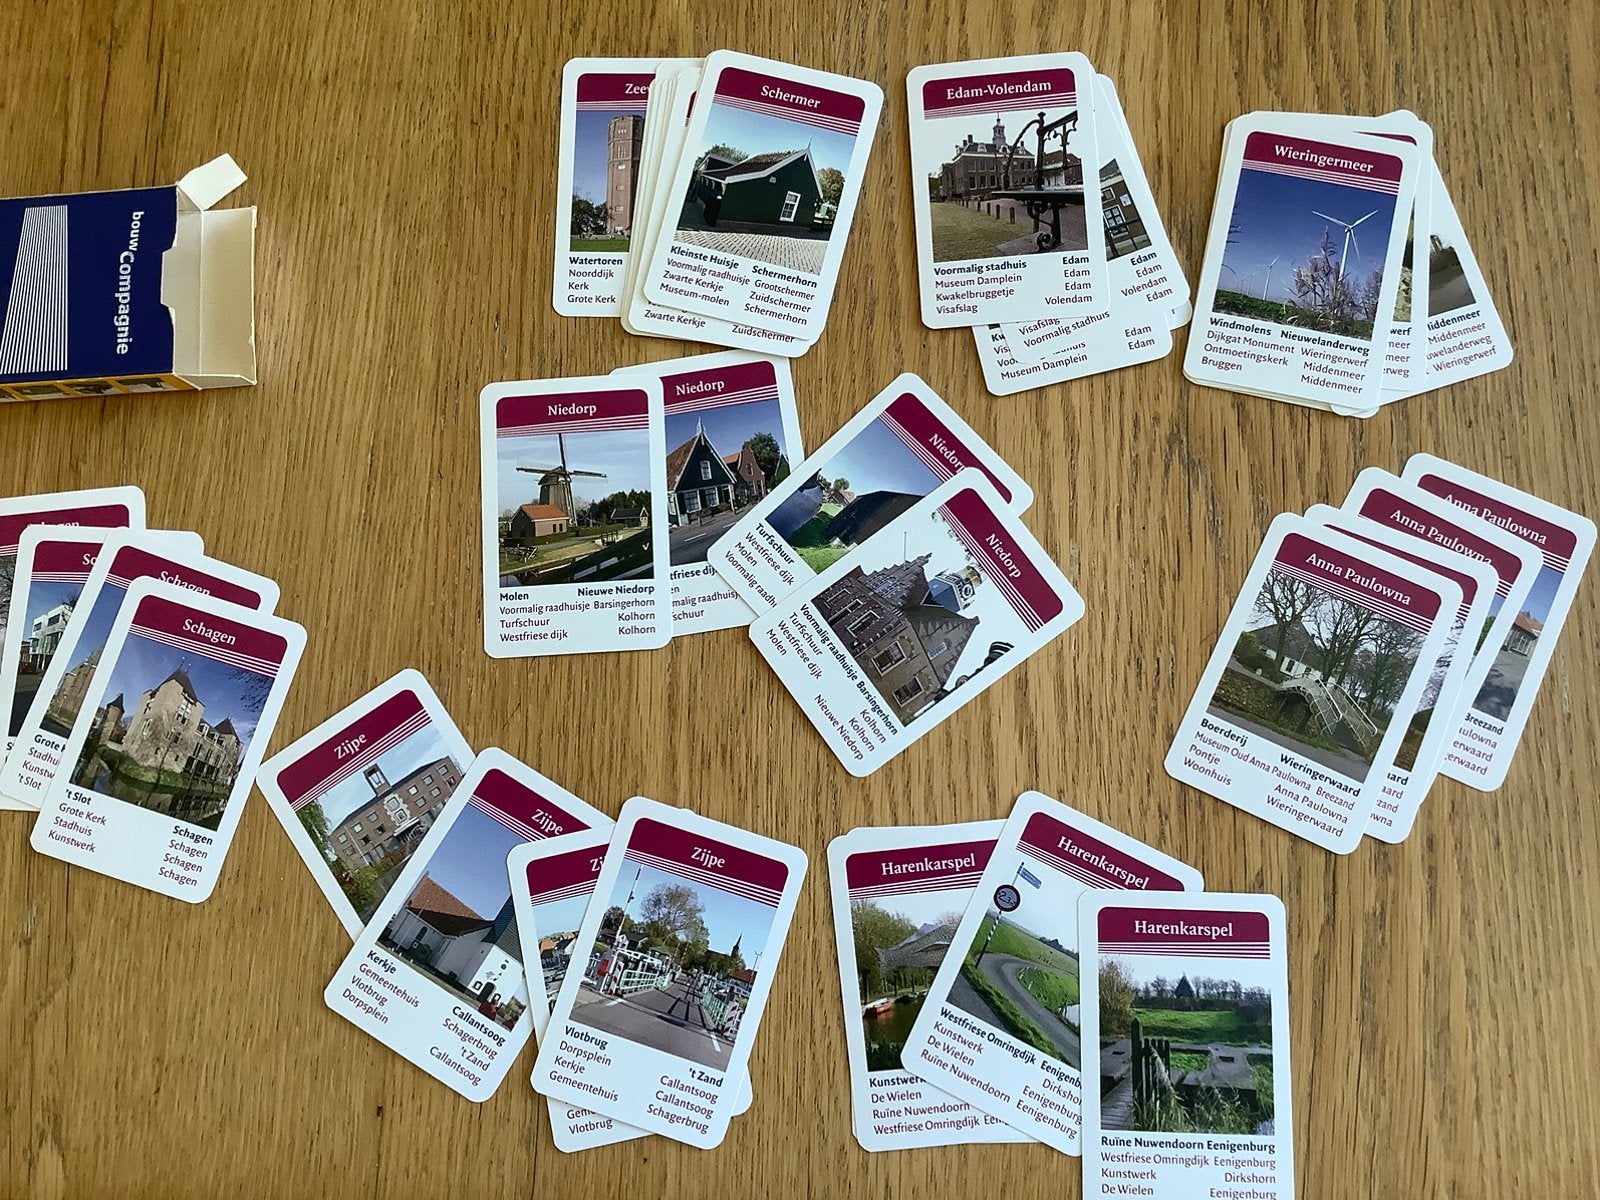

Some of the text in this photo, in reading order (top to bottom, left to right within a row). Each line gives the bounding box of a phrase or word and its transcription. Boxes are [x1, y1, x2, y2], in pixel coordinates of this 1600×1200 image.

[760, 85, 821, 109] Schermer
[946, 80, 1052, 100] Edam-Volendam
[1274, 145, 1374, 173] Wieringermeer
[568, 269, 614, 278] Noorddijk
[569, 257, 623, 265] Watertoren
[670, 246, 817, 289] Kleinste Huisje Schermerhorn
[934, 255, 1089, 276] Voormalig stadhuis Edam
[1131, 251, 1157, 266] Edam
[1136, 263, 1162, 278] Edam
[568, 282, 589, 290] Kerk
[663, 270, 811, 313] Zwarte Kerkje Zuidschermer
[667, 258, 815, 301] Voormalig raadhuisje Grootschermer
[935, 268, 1090, 288] Museum Damplein Edam
[936, 281, 1091, 301] Kwakelbruggetje Edam
[1121, 274, 1168, 297] Volendam
[1146, 286, 1173, 302] Edam
[567, 295, 616, 304] Grote Kerk
[660, 283, 807, 326] Museum-molen Schermerhorn
[936, 294, 1092, 315] Visafslag Volendam
[1207, 330, 1242, 347] Dijkgat
[1243, 337, 1295, 354] Monument
[1300, 347, 1369, 368] Wieringerwerf
[1209, 317, 1369, 357] Windmolens Nieuwelanderweg
[1201, 356, 1363, 394] Bruggen Middenmeer
[1204, 343, 1289, 366] Ontmoetingskerk
[1303, 361, 1365, 381] Middenmeer
[675, 379, 725, 396] Niedorp
[548, 403, 597, 416] Niedorp
[756, 523, 795, 565] Turfschuur
[1390, 510, 1493, 565] Anna Paulowna
[1481, 508, 1547, 544] Paulowna
[725, 550, 757, 588] Voormalig
[734, 541, 758, 566] Molen
[746, 532, 795, 586] Westfriese dijk
[985, 534, 1022, 578] Niedorp
[500, 584, 655, 601] Molen Nieuwe Niedorp
[1306, 553, 1411, 606] Anna Paulowna
[500, 598, 655, 616] Voormalig raadhuisje Barsingerhorn
[500, 611, 656, 629] Turfschuur Kolhorn
[182, 619, 236, 646] Schagen
[500, 625, 656, 642] Westfriese dijk Kolhorn
[777, 620, 875, 752] Westfriese dijk Kolhorn
[788, 612, 886, 744] Turfschuur Kolhorn
[800, 604, 898, 736] Voormalig raadhuisje Barsingerhorn
[765, 628, 864, 761] Molen Nieuwe Niedorp
[334, 733, 367, 760] Zijpe
[1200, 718, 1361, 797] Boerderij Wieringerwaard
[1189, 744, 1220, 765] Pontje
[1274, 784, 1300, 802] Anna
[1301, 797, 1348, 824] Paulowna
[1194, 731, 1230, 753] Museum
[1249, 758, 1270, 772] Anna
[1271, 767, 1311, 791] Paulowna
[1316, 787, 1355, 811] Breezand
[1183, 757, 1343, 838] Woonhuis Wieringerwaard
[59, 803, 208, 859] Grote Kerk Schagen
[65, 789, 213, 846] 't Slot Schagen
[530, 809, 563, 836] Zijpe
[48, 830, 198, 886] Kunstwerk Schagen
[53, 816, 203, 873] Stadhuis Schagen
[690, 847, 726, 868] Zijpe
[1056, 835, 1150, 890] Harenkarspel
[881, 853, 976, 875] Harenkarspel
[1134, 920, 1234, 937] Harenkarspel
[359, 964, 498, 1060] Gemeentehuis Schagerbrug
[366, 950, 506, 1047] Kerkje Callantsoog
[342, 988, 481, 1087] Dorpsplein Callantsoog
[351, 975, 388, 1007] Vlotbrug
[466, 1052, 491, 1072] Zand
[933, 1021, 984, 1054] Kunstwerk
[940, 1006, 1037, 1065] Westfriese Omringdijk
[559, 1041, 718, 1104] Dorpsplein Callantsoog
[565, 1026, 724, 1088] Vlotbrug 't Zand
[554, 1056, 714, 1119] Kerkje Callantsoog
[871, 1091, 922, 1104] De Wielen
[920, 1049, 1078, 1139] Ruïne Nuwendoorn Eenigenburg
[927, 1035, 942, 1048] De
[942, 1044, 975, 1066] Wielen
[1022, 1086, 1082, 1125] Eenigenburg
[549, 1071, 709, 1134] Gemeentehuis Schagerbrug
[873, 1102, 971, 1119] Ruïne Nuwendoorn
[873, 1122, 923, 1135] Westfriese
[925, 1116, 980, 1133] Omringdijk
[1101, 1136, 1275, 1154] Ruïne Nuwendoorn Eenigenburg
[1101, 1152, 1276, 1170] Westfriese Omringdijk Eenigenburg
[1101, 1168, 1276, 1183] Kunstwerk Dirkshorn
[1101, 1184, 1276, 1200] De Wielen Eenigenburg
